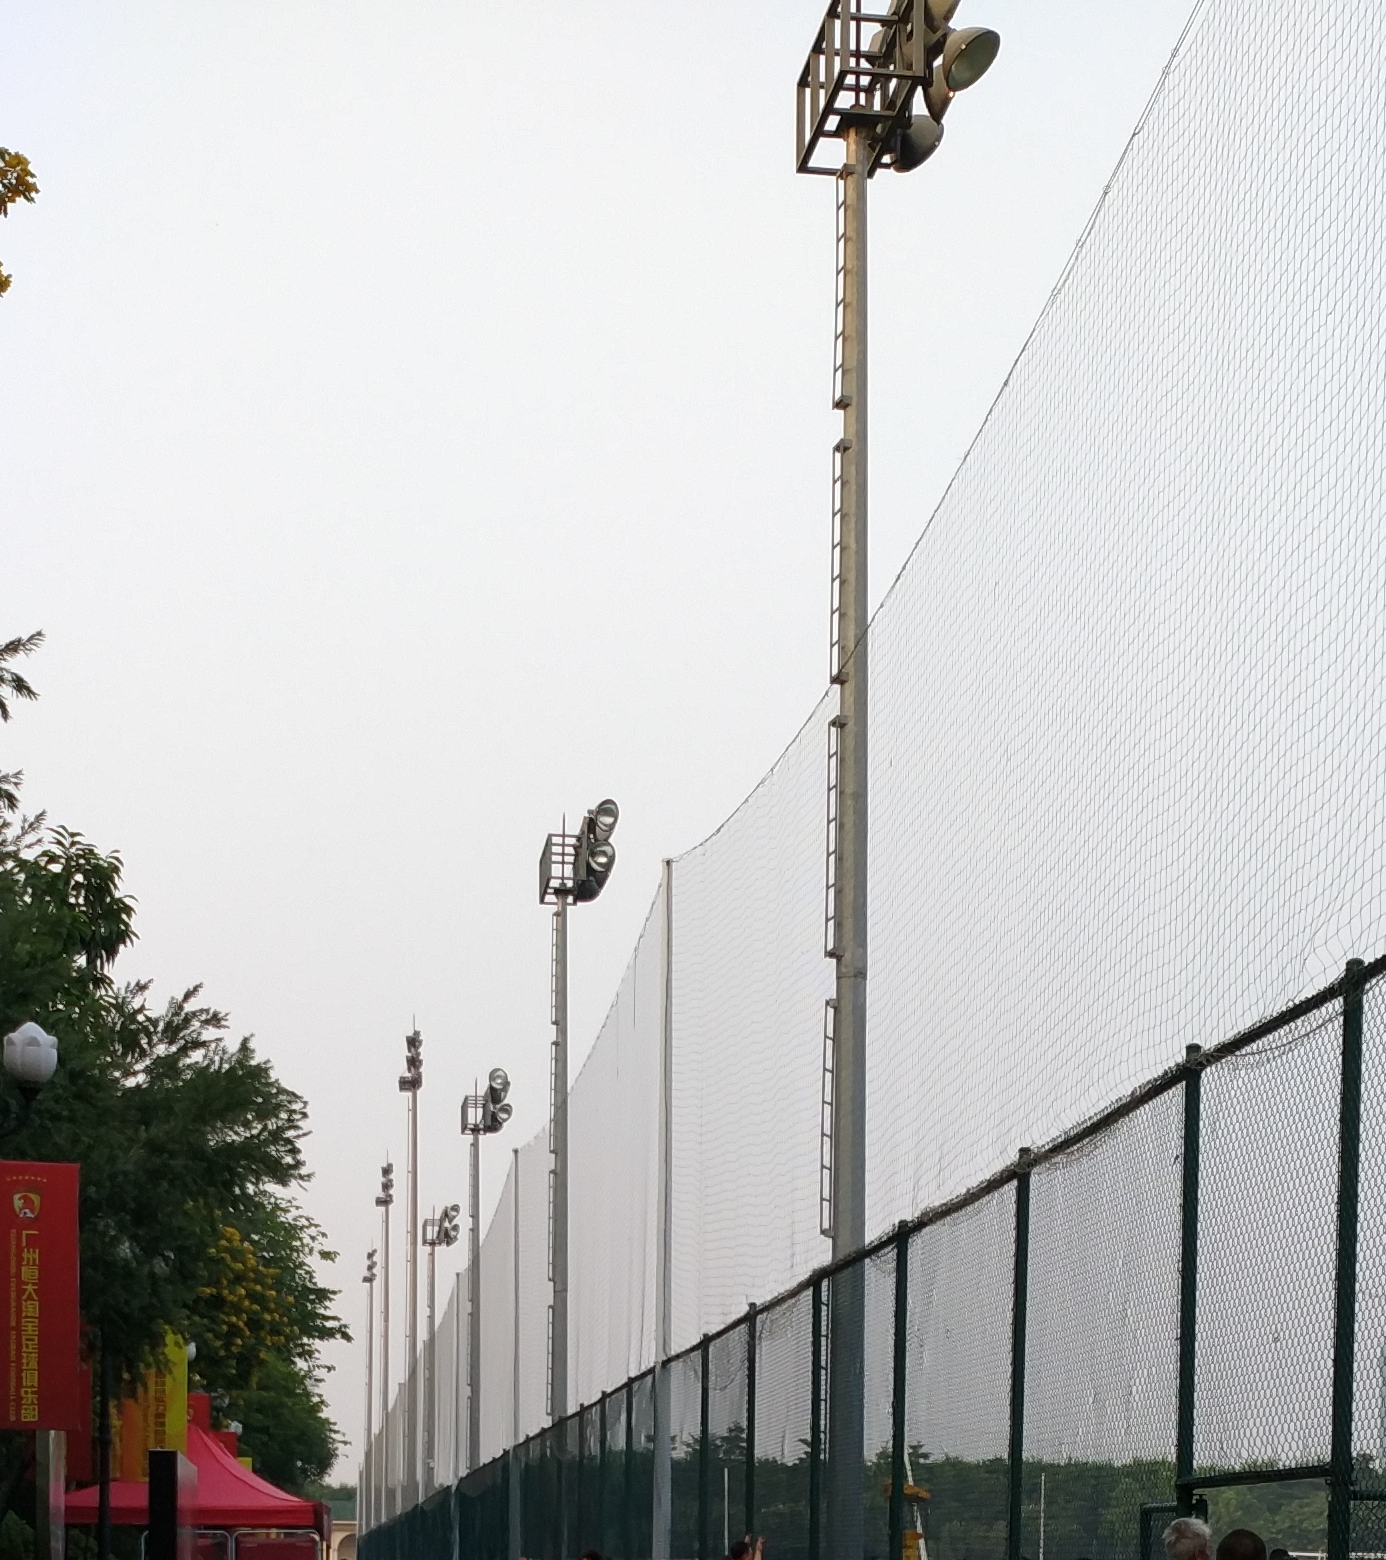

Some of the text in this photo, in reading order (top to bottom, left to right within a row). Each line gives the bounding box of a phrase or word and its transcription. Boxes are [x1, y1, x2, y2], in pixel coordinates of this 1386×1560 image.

[20, 1229, 40, 1423] 广州恒大淘宝足球俱乐部
